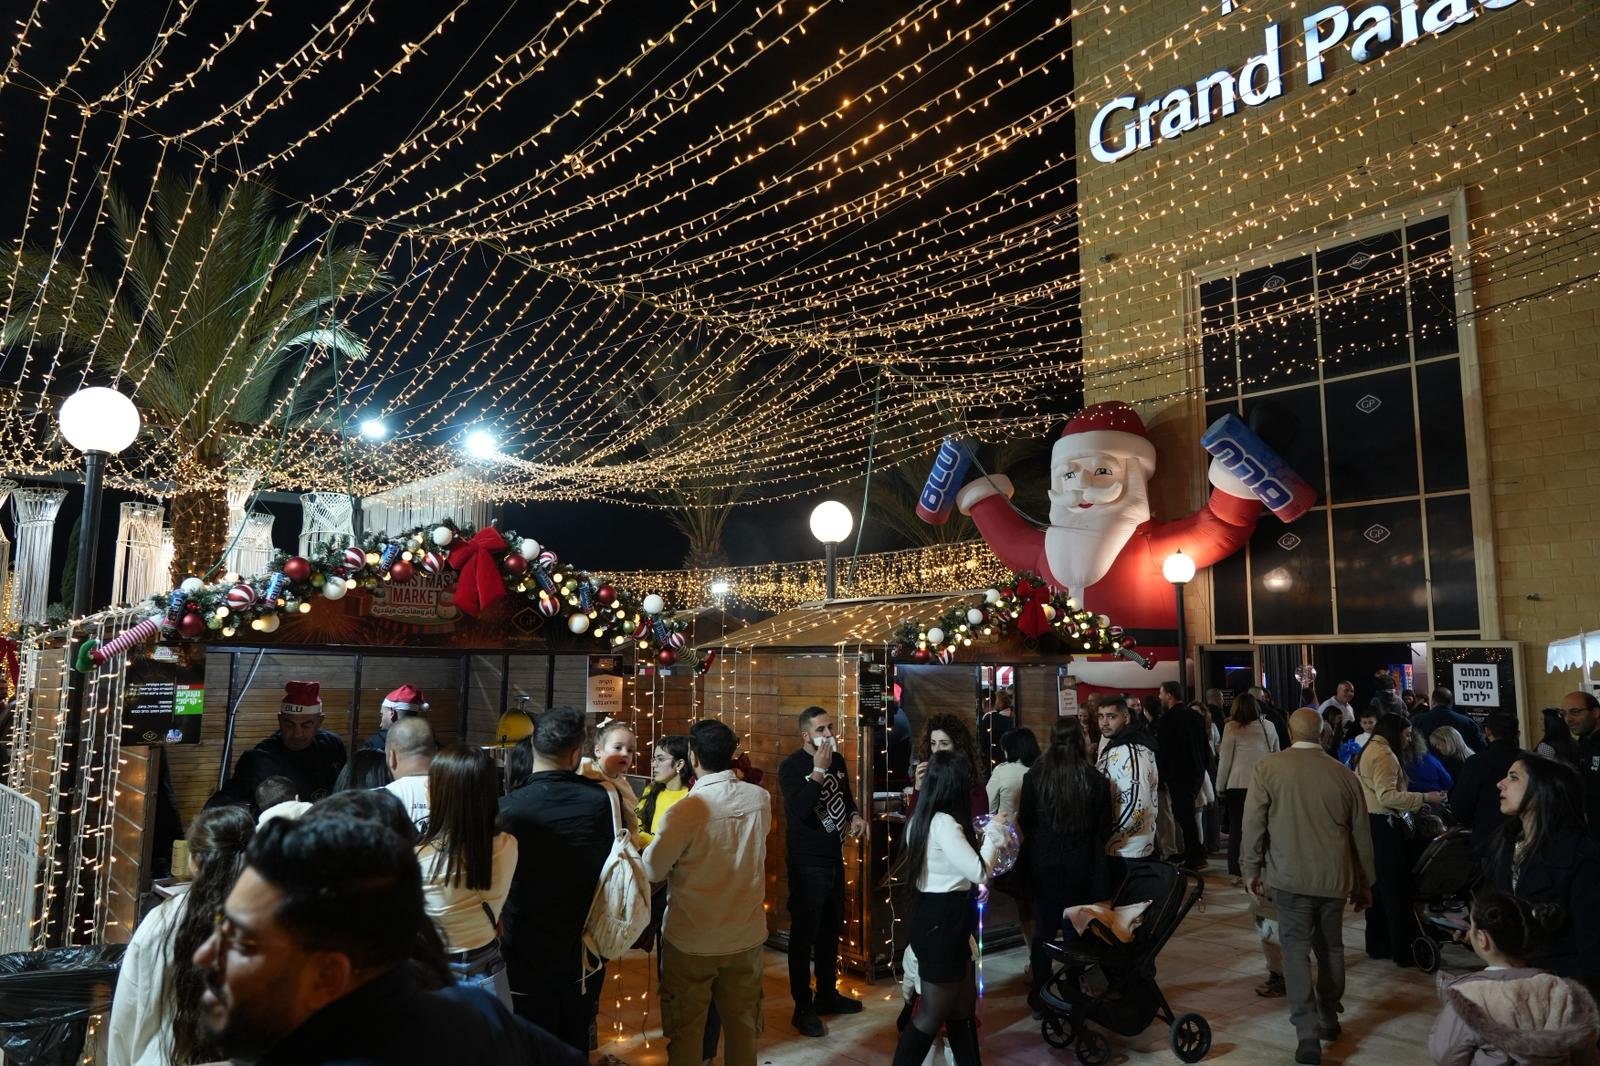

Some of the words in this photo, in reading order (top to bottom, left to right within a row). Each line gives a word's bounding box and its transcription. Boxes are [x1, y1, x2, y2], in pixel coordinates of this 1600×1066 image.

[1088, 23, 1283, 163] Grand
[1303, 0, 1518, 85] Pala
[1361, 399, 1376, 410] GP
[1368, 528, 1384, 539] GP
[1282, 537, 1296, 546] GP
[392, 587, 441, 605] MARKET
[1460, 667, 1490, 677] מתחם
[1458, 680, 1493, 690] משחקי
[1462, 691, 1491, 702] ילדים
